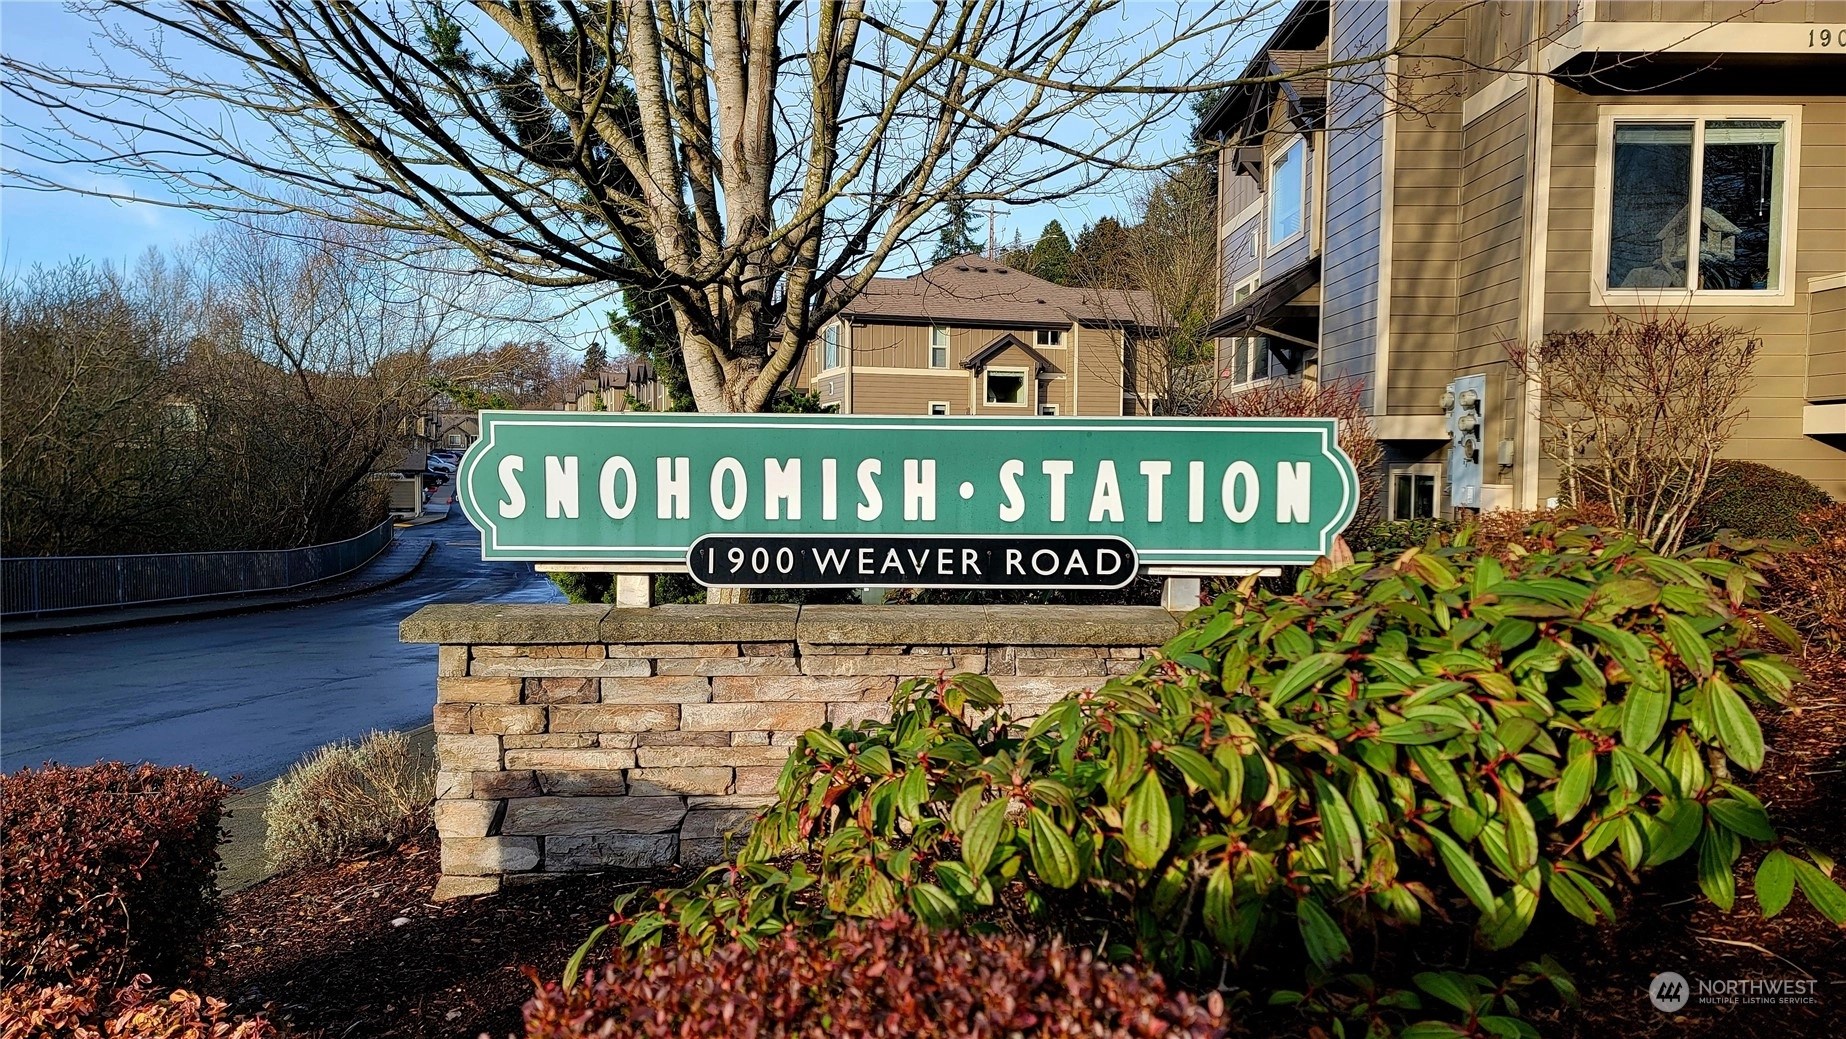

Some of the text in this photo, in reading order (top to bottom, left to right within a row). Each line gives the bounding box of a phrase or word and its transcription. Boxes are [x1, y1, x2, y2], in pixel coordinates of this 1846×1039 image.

[498, 455, 937, 523] SNOHOMISH
[999, 458, 1312, 524] STATION
[707, 547, 1121, 576] 1900 WEAVER ROAD
